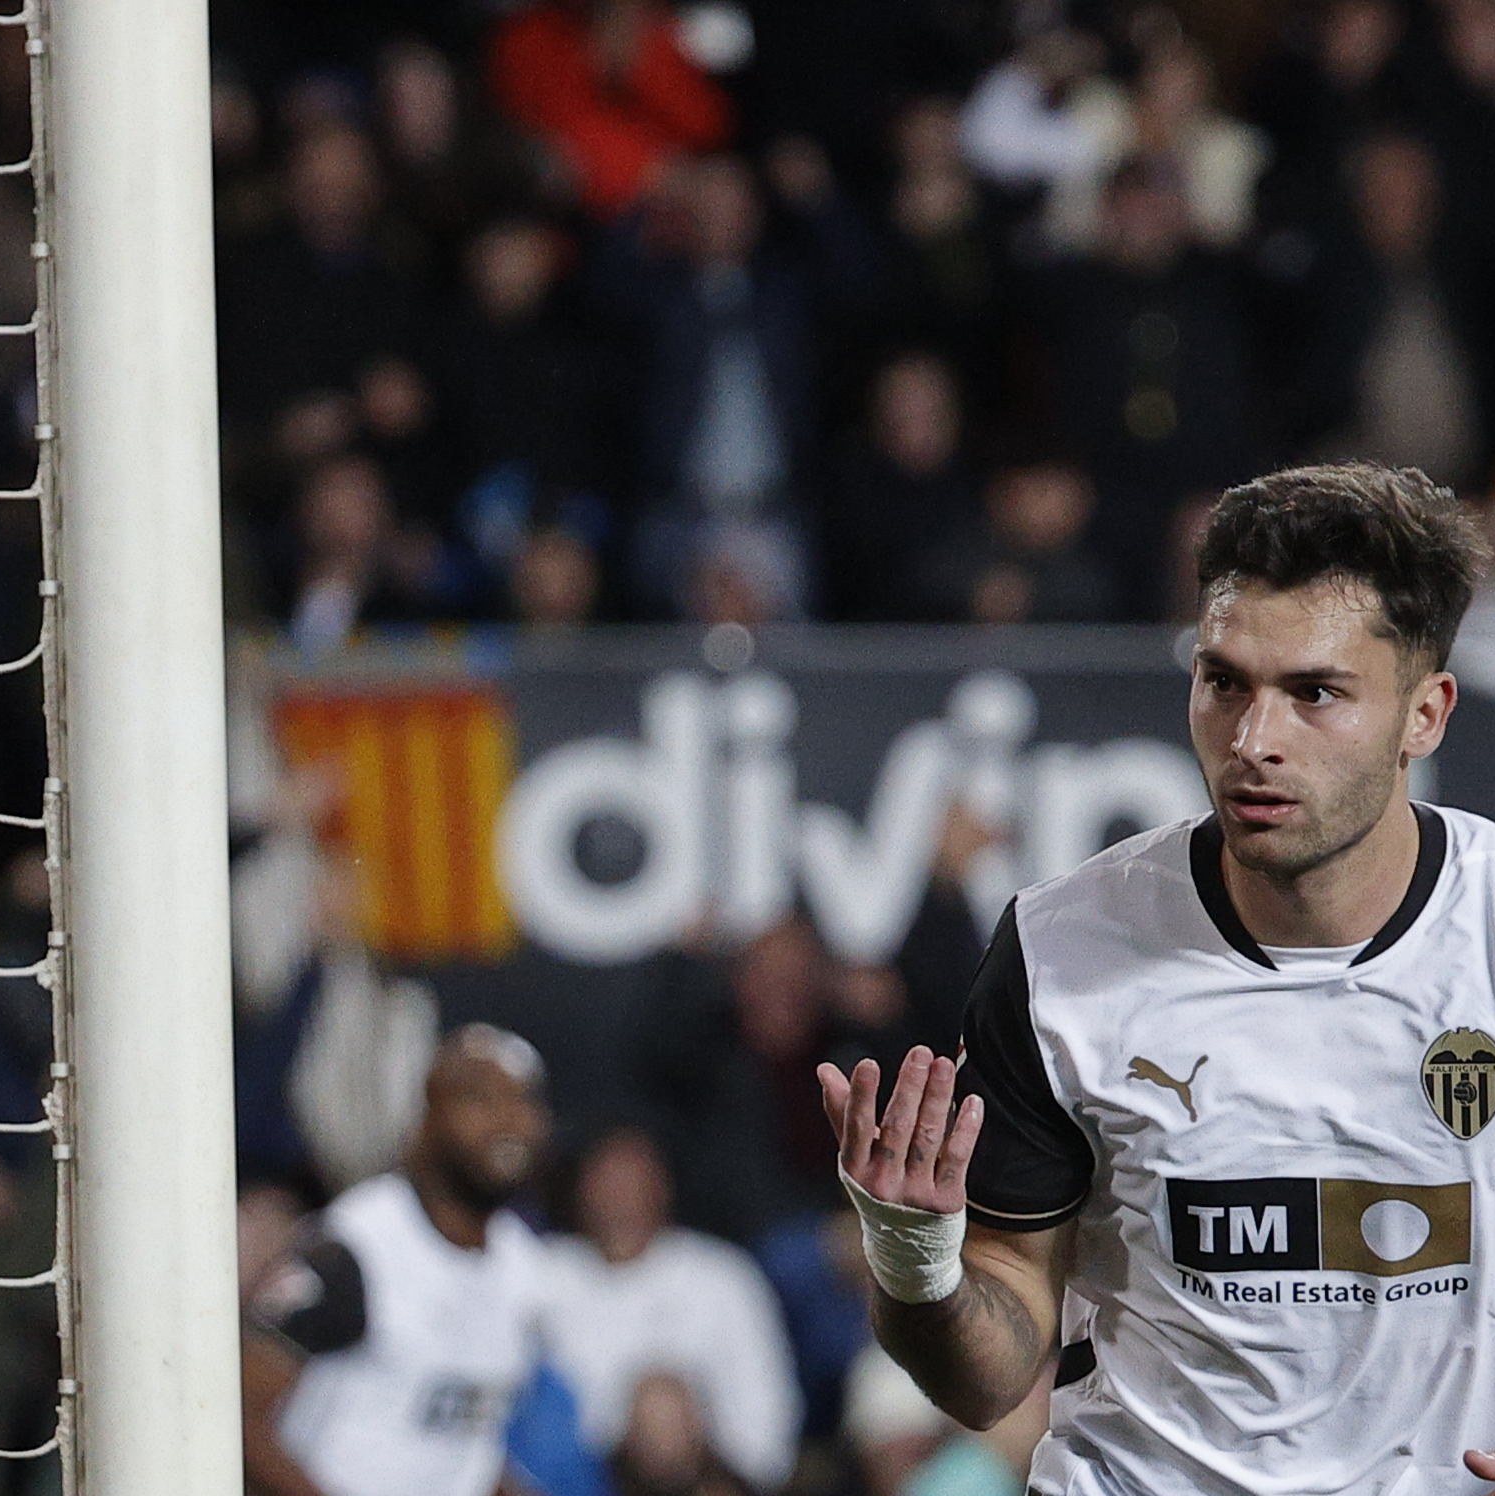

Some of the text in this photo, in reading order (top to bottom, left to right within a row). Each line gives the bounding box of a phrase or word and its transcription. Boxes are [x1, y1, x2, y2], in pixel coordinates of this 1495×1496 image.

[493, 670, 1217, 968] divin
[1187, 1205, 1288, 1254] TM
[1176, 1268, 1469, 1305] TM Real Estate Group
